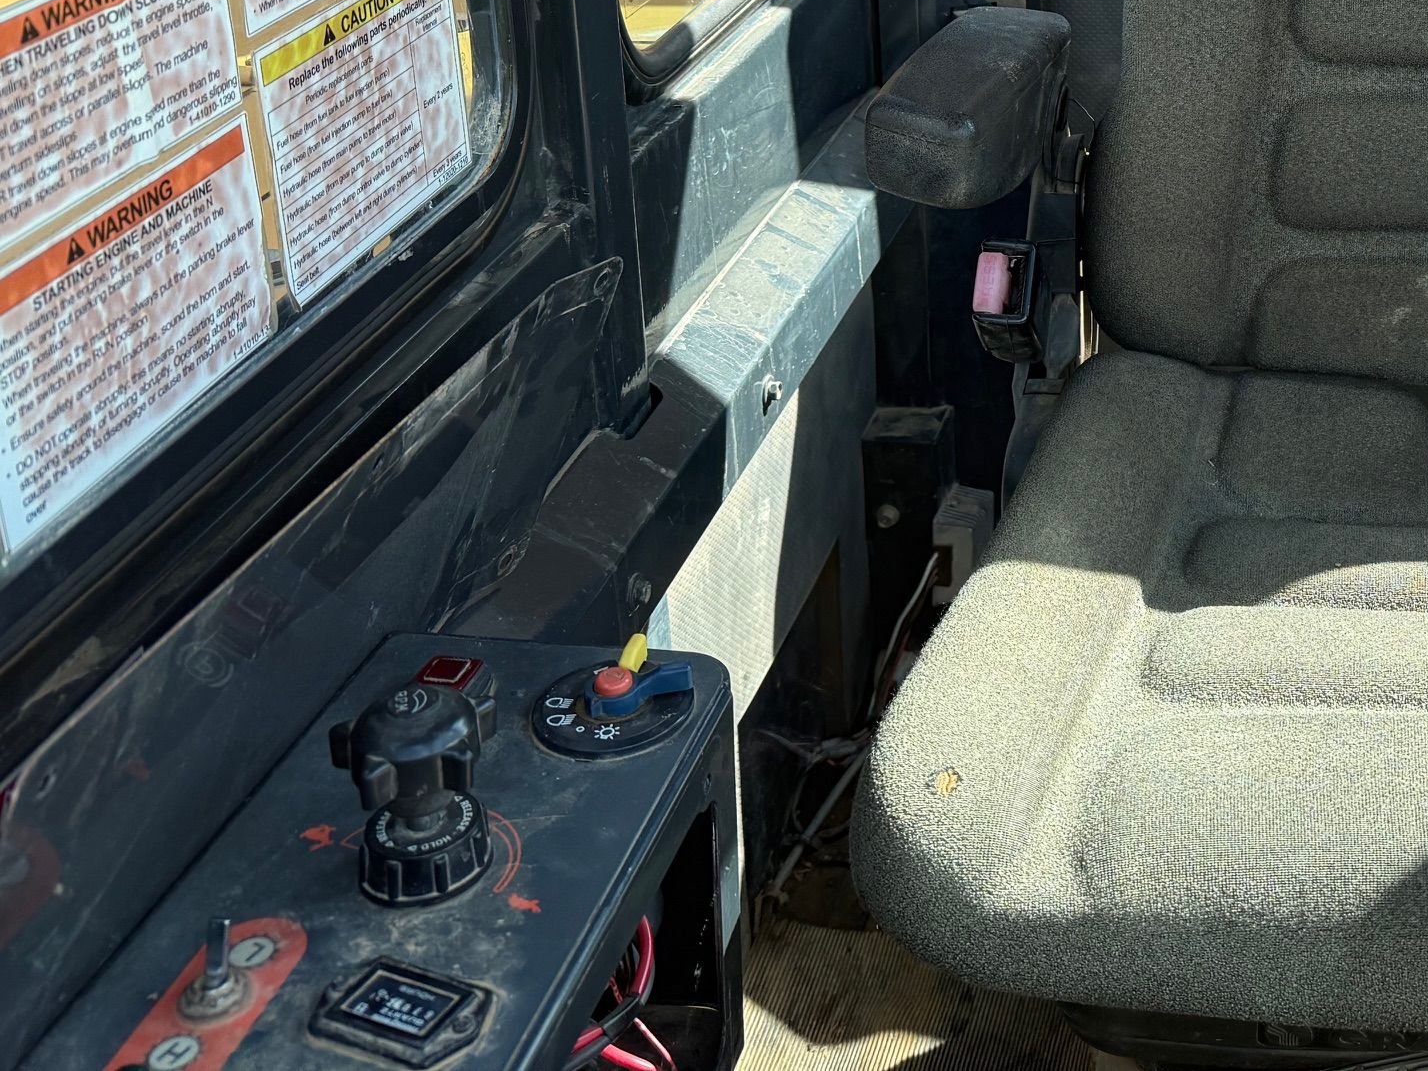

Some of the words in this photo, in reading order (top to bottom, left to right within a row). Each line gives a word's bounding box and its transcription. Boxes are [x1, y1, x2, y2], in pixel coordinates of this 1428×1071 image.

[25, 18, 95, 64] TRAVELING
[97, 0, 133, 29] DOWN
[145, 1, 174, 25] engine
[160, 14, 181, 35] level
[181, 0, 213, 24] throttle,
[414, 3, 441, 26] Replacement
[153, 58, 171, 76] The
[173, 38, 208, 66] machine
[288, 62, 320, 91] Replace
[321, 54, 334, 69] the
[334, 31, 368, 61] following
[369, 20, 387, 41] parts
[166, 86, 187, 106] more
[188, 75, 207, 93] than
[207, 68, 220, 82] the
[304, 84, 328, 105] Periodic
[328, 61, 360, 90] replacement
[360, 54, 373, 69] parts
[423, 93, 436, 109] Every
[436, 90, 440, 99] 2
[440, 81, 453, 97] years
[69, 161, 89, 181] This
[90, 150, 110, 171] may
[166, 92, 208, 124] dangerous
[209, 74, 237, 100] slipping
[188, 90, 235, 125] 1-41010-1290
[276, 135, 289, 151] Fuel
[288, 127, 303, 142] hose
[303, 117, 317, 134] (from
[317, 109, 327, 122] fuel
[327, 102, 338, 116] tank
[339, 98, 344, 108] to
[344, 91, 354, 104] fuel
[354, 78, 373, 98] injection
[374, 67, 390, 85] pump)
[432, 162, 445, 179] Every
[449, 149, 462, 166] years
[86, 177, 172, 249] WARNING
[140, 231, 162, 255] travel
[162, 217, 182, 239] lever
[183, 211, 191, 224] in
[192, 202, 205, 218] the
[206, 194, 213, 209] N
[154, 248, 163, 261] or
[164, 238, 177, 255] the
[178, 220, 203, 245] switch
[203, 214, 211, 227] in
[211, 205, 223, 221] the
[32, 260, 93, 312] STARTING
[95, 229, 138, 269] ENGINE
[140, 212, 163, 239] AND
[165, 178, 212, 221] MACHINE
[159, 276, 172, 297] put
[172, 268, 186, 284] the
[187, 246, 215, 276] parking
[215, 230, 236, 253] brake
[236, 216, 254, 237] lever
[160, 307, 185, 335] sound
[185, 298, 199, 315] the
[199, 284, 217, 305] horn
[217, 271, 231, 291] and
[232, 258, 250, 279] start.
[296, 274, 309, 290] Seat
[308, 266, 319, 280] belt
[173, 331, 210, 369] Operating
[211, 307, 240, 338] abruptly
[240, 295, 255, 315] may
[157, 372, 181, 397] cause
[182, 360, 195, 377] the
[195, 334, 227, 366] machine
[227, 327, 235, 340] to
[236, 316, 247, 333] fall
[15, 453, 33, 476] DO
[34, 433, 57, 461] NOT
[187, 312, 214, 341] starting
[215, 288, 245, 318] abruptly,
[25, 499, 46, 523] over
[458, 799, 474, 833] RELEASE
[421, 835, 453, 852] HOLD
[244, 942, 264, 963] L
[157, 1041, 193, 1065] H
